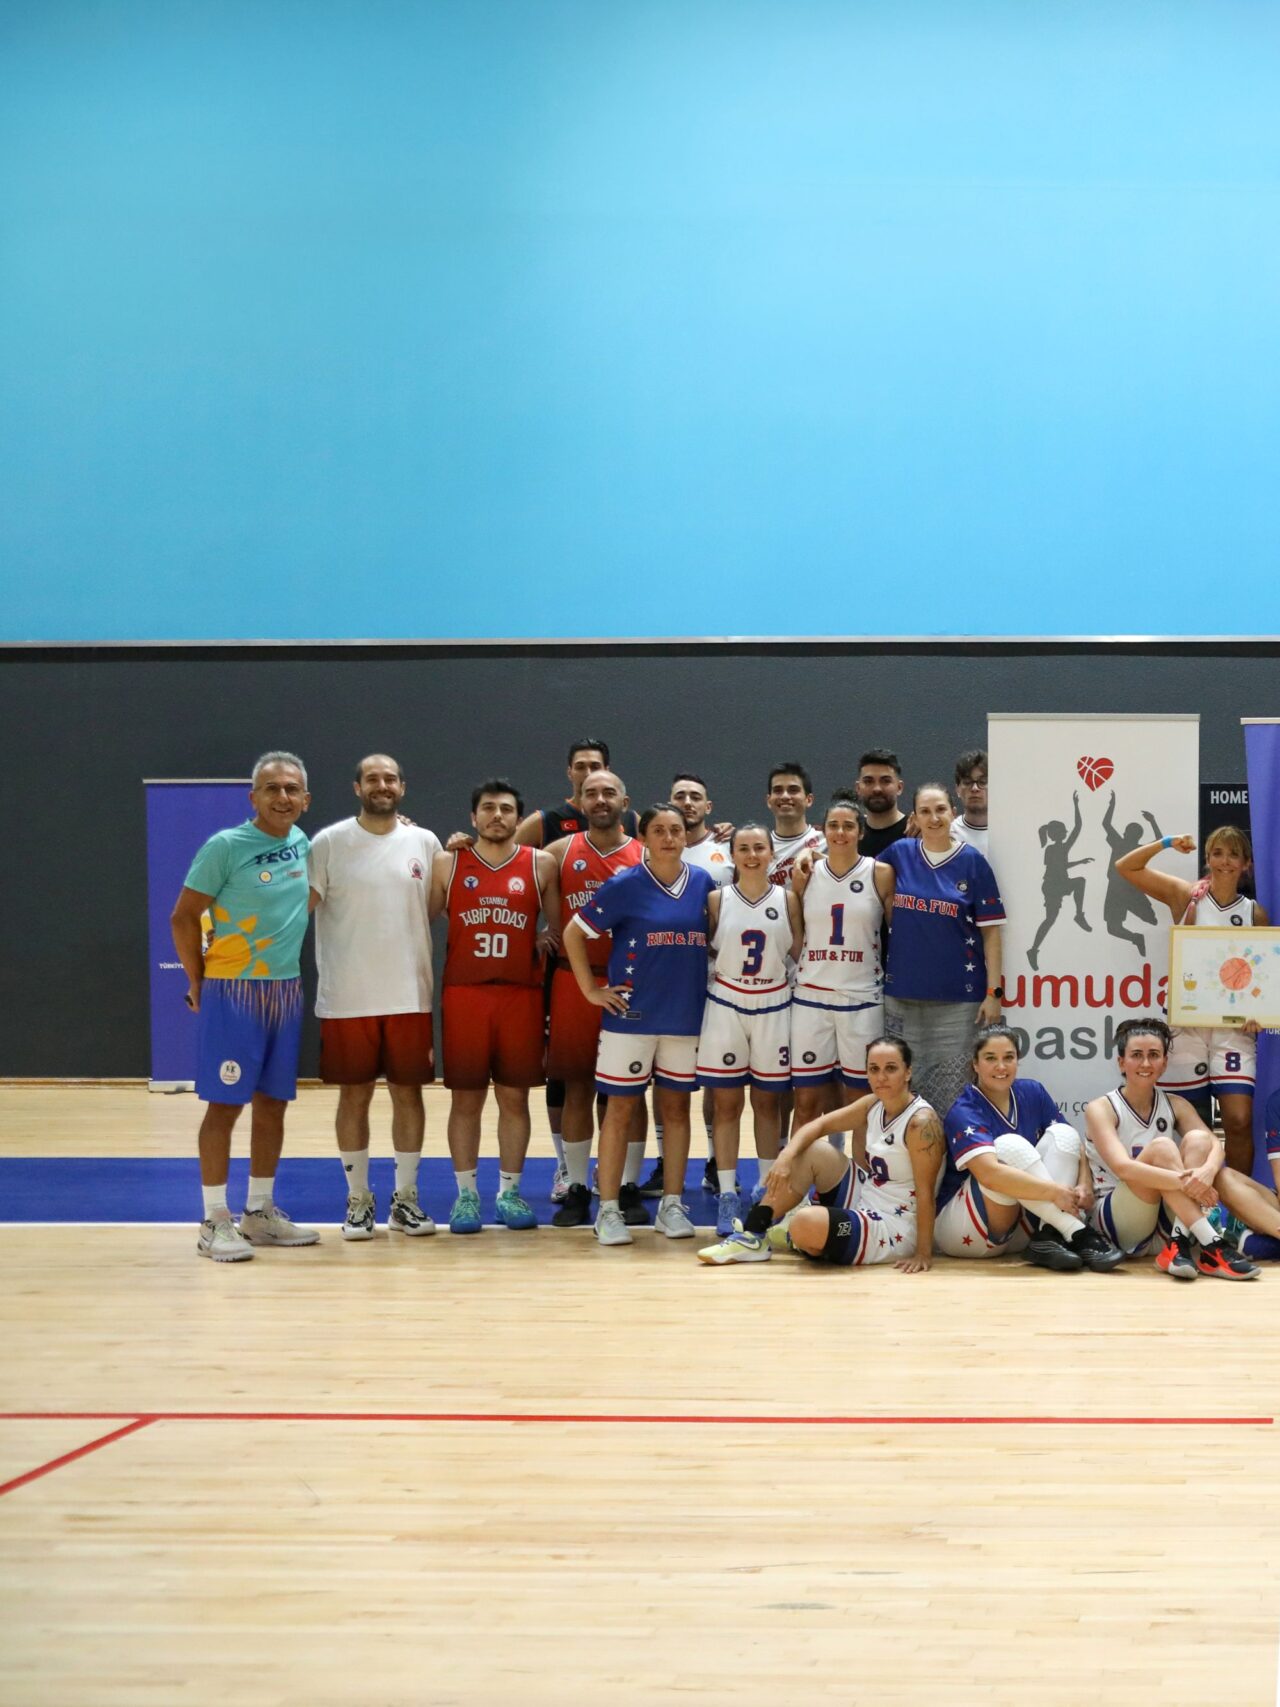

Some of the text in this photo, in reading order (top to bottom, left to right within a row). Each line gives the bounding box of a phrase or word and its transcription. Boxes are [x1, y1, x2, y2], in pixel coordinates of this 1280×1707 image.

[1210, 790, 1249, 804] HOME
[929, 898, 959, 918] FUN
[829, 903, 845, 946] 1
[473, 932, 508, 958] 30
[646, 931, 675, 947] RUN
[675, 932, 687, 946] &
[740, 929, 767, 977] 3
[808, 949, 864, 963] RUN & FUN
[779, 1046, 790, 1067] 3
[1225, 1051, 1241, 1073] 8
